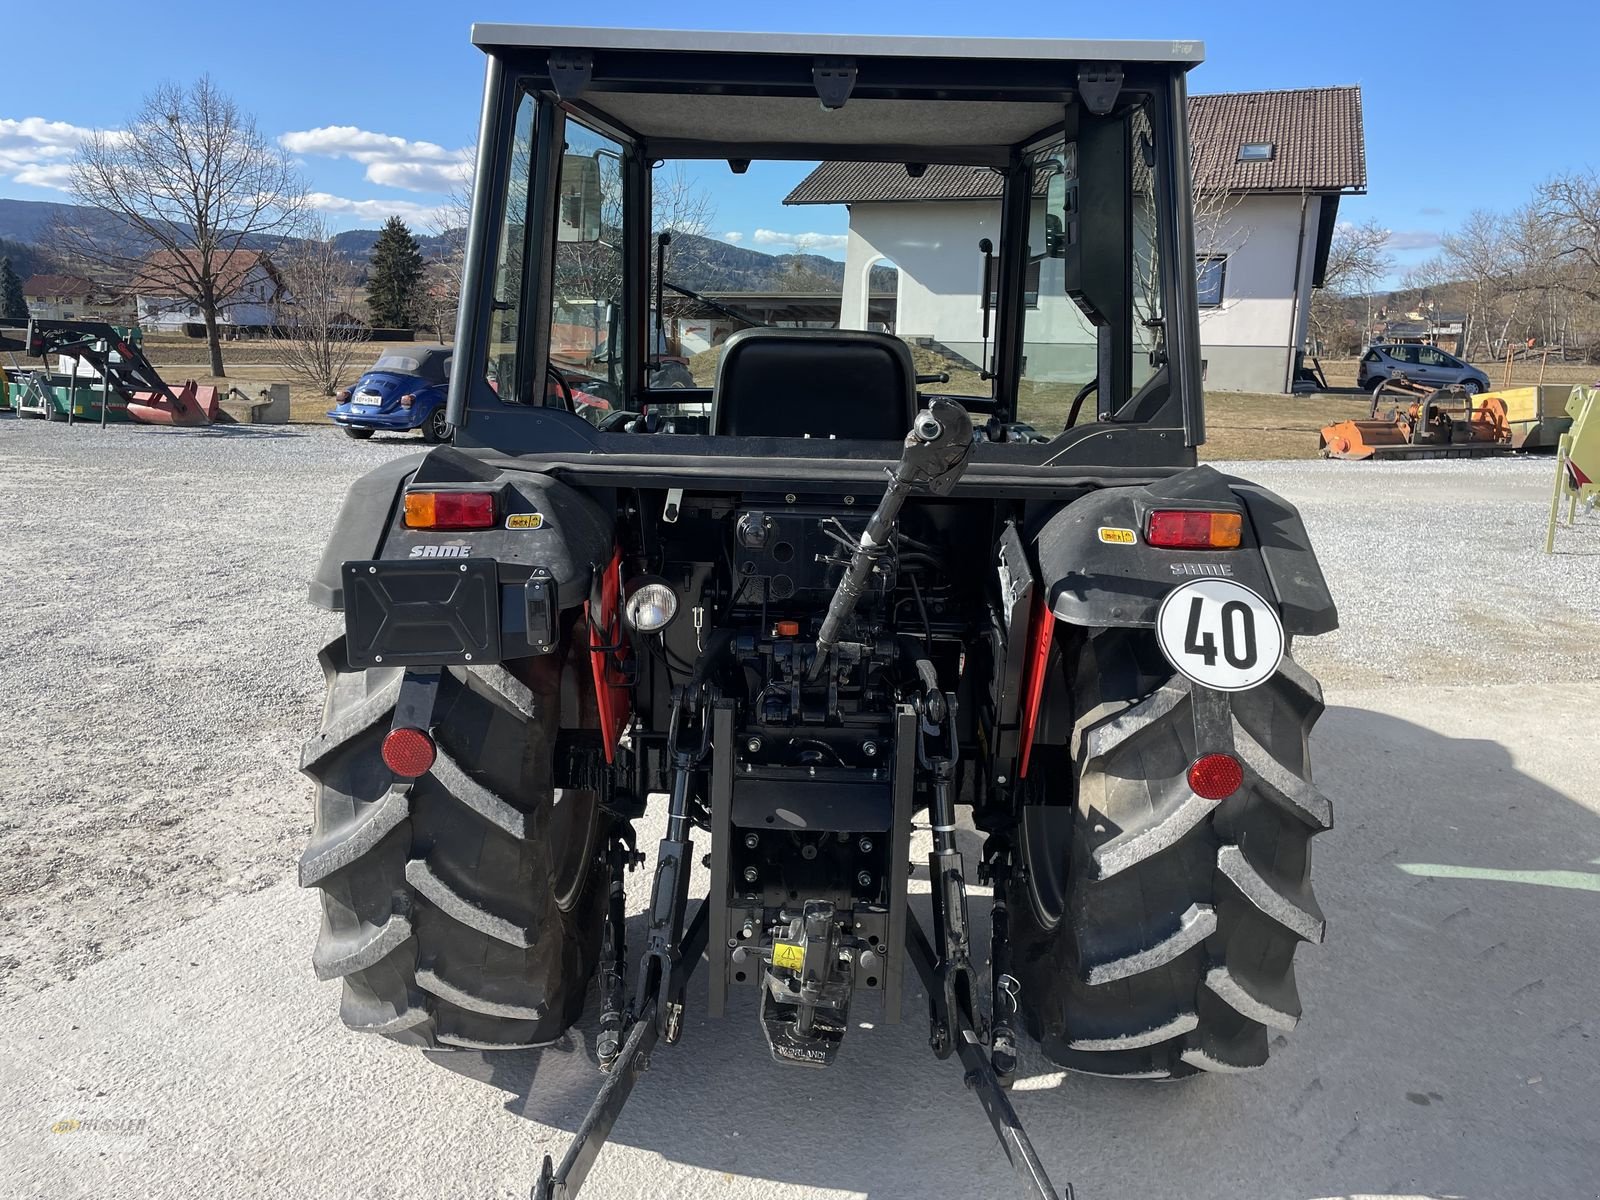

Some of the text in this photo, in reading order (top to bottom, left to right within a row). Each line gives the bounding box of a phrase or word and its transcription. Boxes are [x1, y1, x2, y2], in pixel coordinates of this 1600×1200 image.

[409, 545, 472, 557] SAME
[1170, 563, 1234, 576] SAME
[1184, 597, 1258, 670] 40
